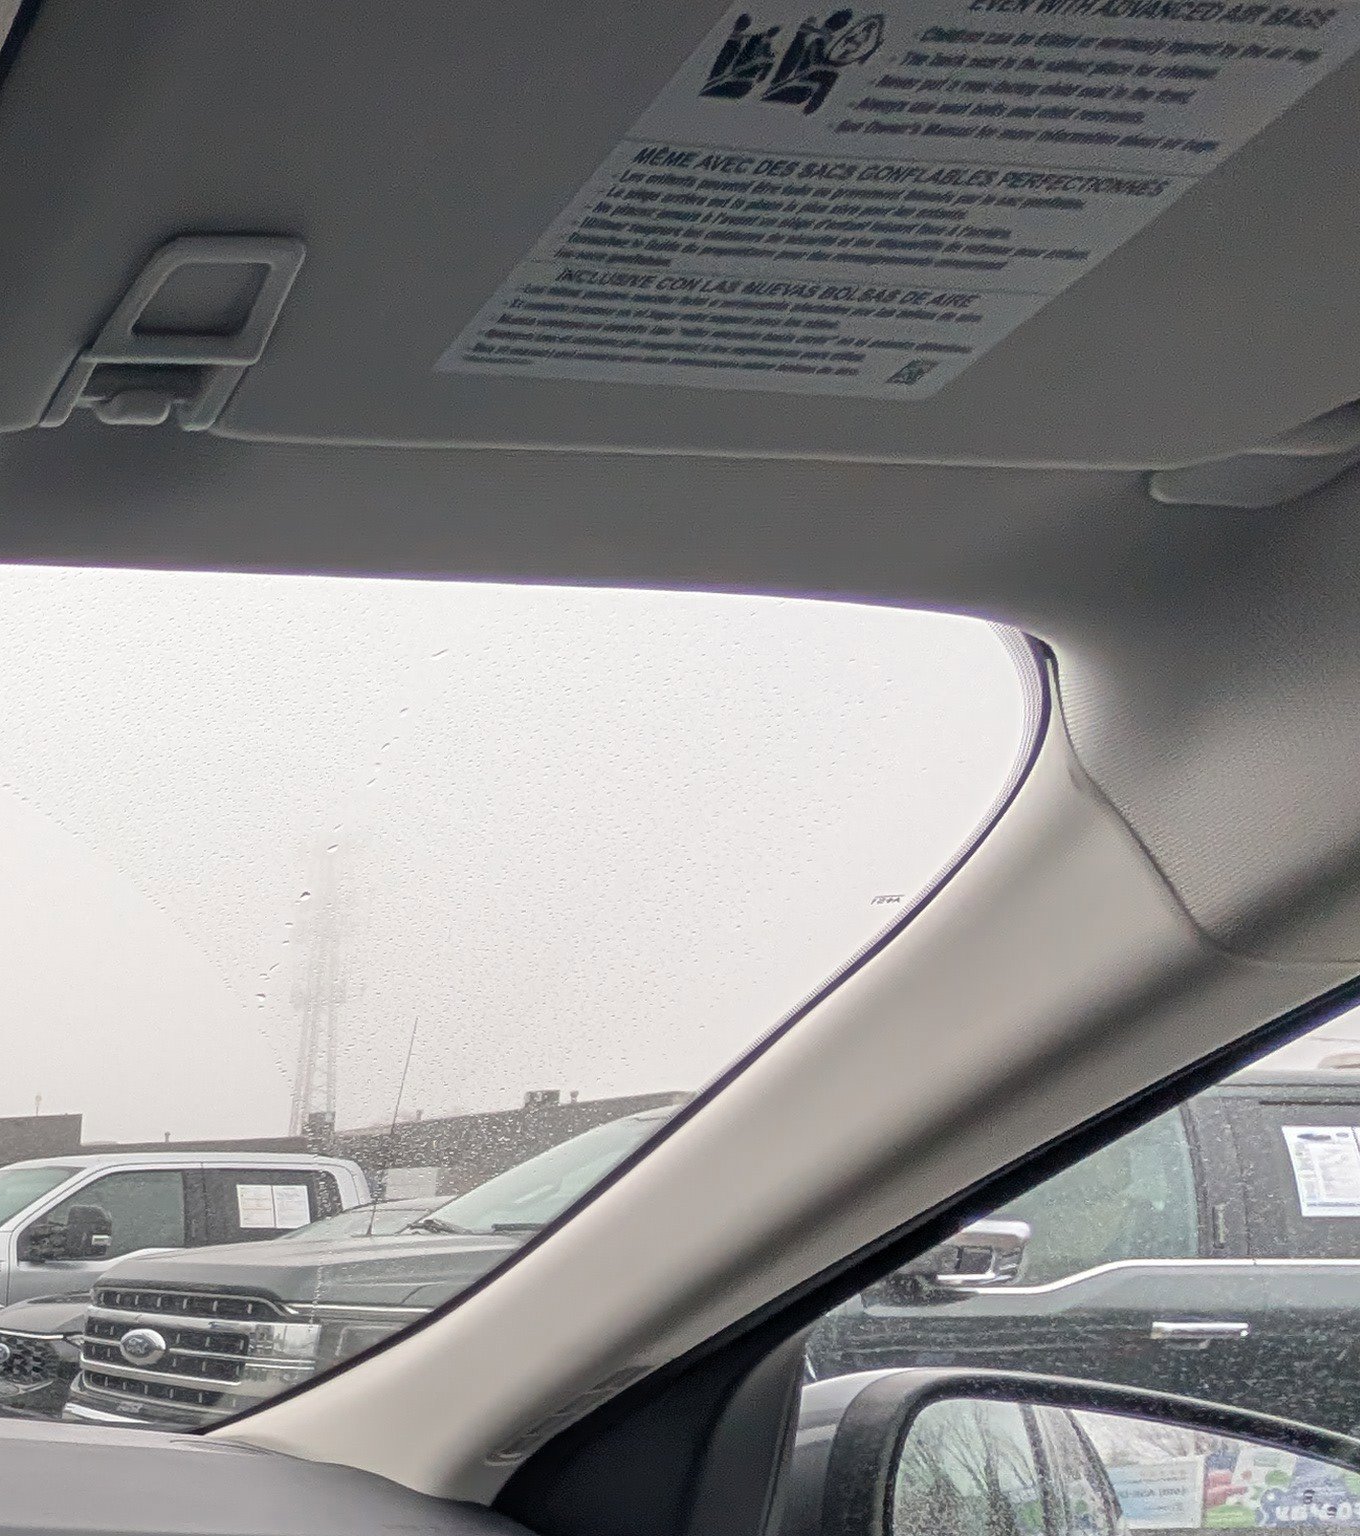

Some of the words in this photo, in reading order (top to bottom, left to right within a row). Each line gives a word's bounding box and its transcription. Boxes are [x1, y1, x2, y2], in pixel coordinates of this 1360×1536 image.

[1090, 0, 1225, 21] ADVANCED
[633, 145, 699, 168] MÊME
[695, 154, 754, 173] AVEC
[754, 159, 799, 176] DES
[798, 161, 858, 180] SACS
[858, 162, 999, 188] GONFLABLES
[656, 276, 699, 291] CON
[701, 278, 740, 294] LAS
[741, 281, 820, 298] NUEVAS
[819, 285, 901, 303] BOLSAS
[900, 290, 929, 304] DE
[928, 292, 979, 307] AIRE
